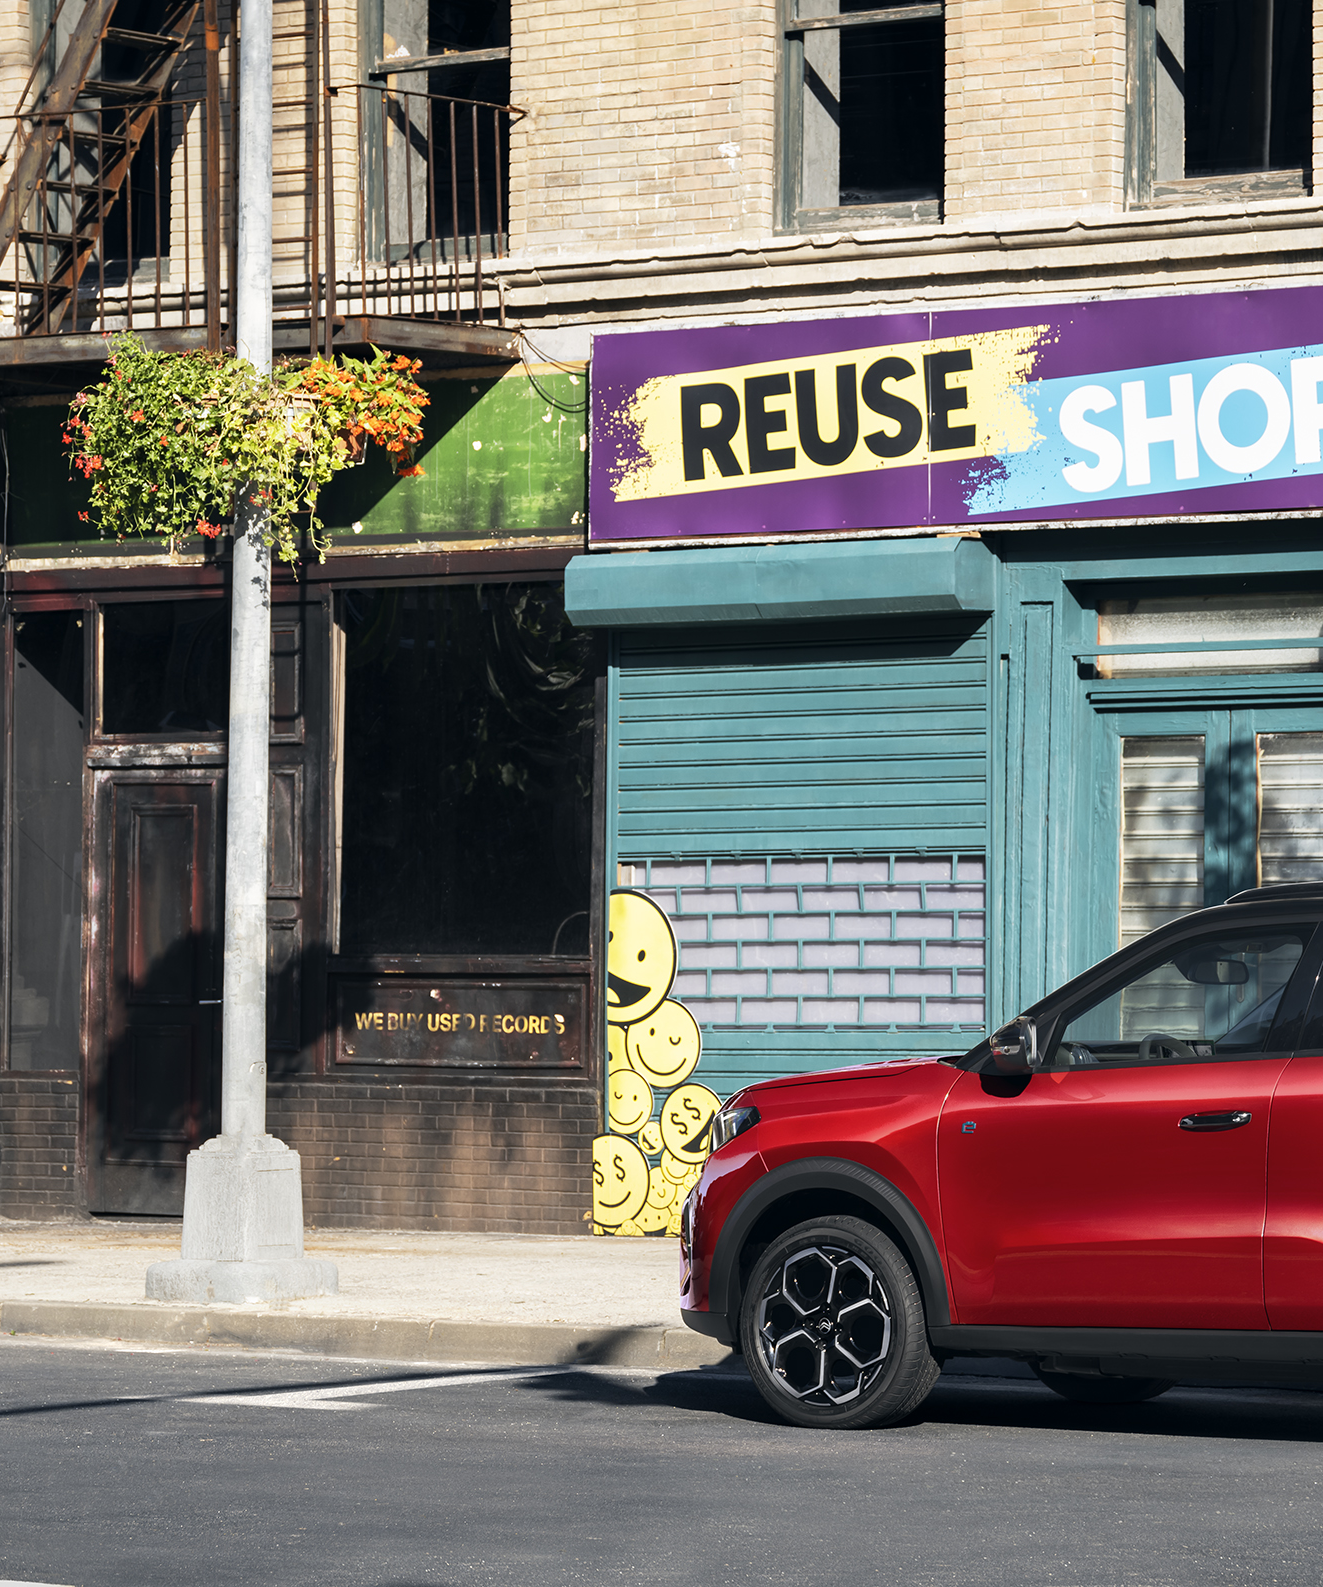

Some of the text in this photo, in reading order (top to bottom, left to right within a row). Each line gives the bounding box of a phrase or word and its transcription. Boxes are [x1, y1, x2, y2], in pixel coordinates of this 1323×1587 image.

[680, 348, 977, 482] REUSE
[354, 1012, 384, 1031] WE
[387, 1013, 424, 1032] BUY
[479, 1014, 566, 1035] RECORDS
